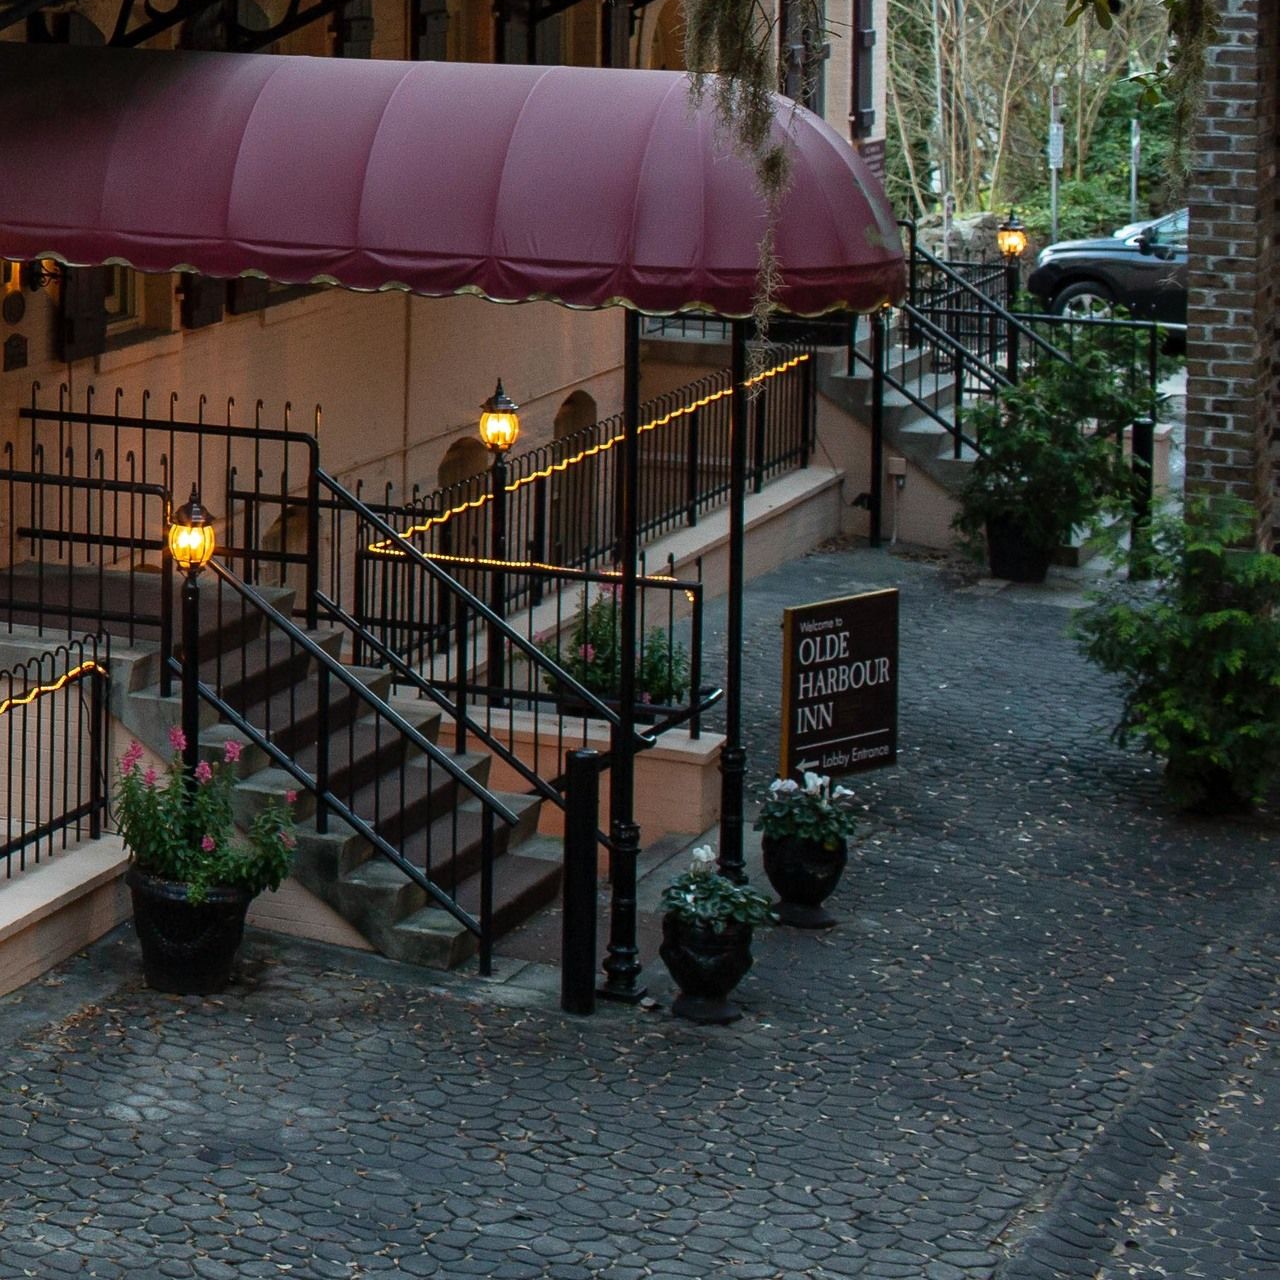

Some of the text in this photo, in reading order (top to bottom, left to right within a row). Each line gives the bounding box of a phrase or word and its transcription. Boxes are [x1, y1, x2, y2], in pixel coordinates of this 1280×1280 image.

[800, 618, 843, 633] Welcome to
[799, 631, 850, 665] OLDE
[798, 657, 890, 700] HARBOUR
[796, 702, 834, 734] INN
[822, 745, 889, 768] Lobby Entrance
